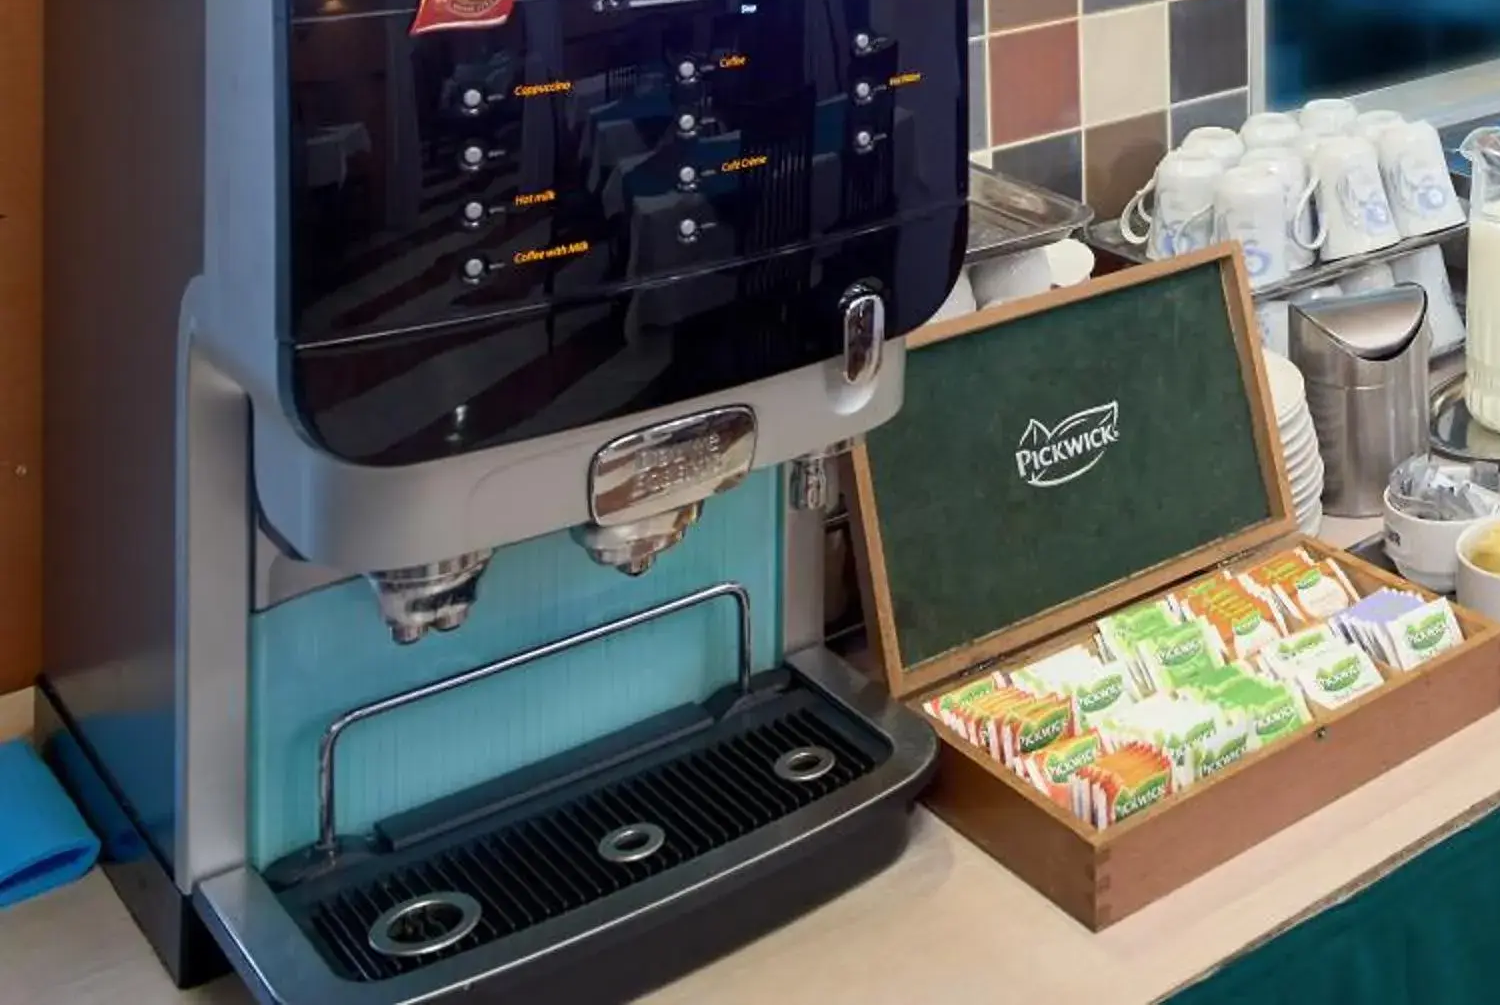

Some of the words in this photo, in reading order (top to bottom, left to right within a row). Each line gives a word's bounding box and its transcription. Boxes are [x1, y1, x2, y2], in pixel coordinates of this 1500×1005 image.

[514, 81, 571, 97] Cappuccino
[515, 194, 534, 206] Hot
[513, 250, 544, 264] Coffee
[1016, 424, 1119, 477] PICKWICK
